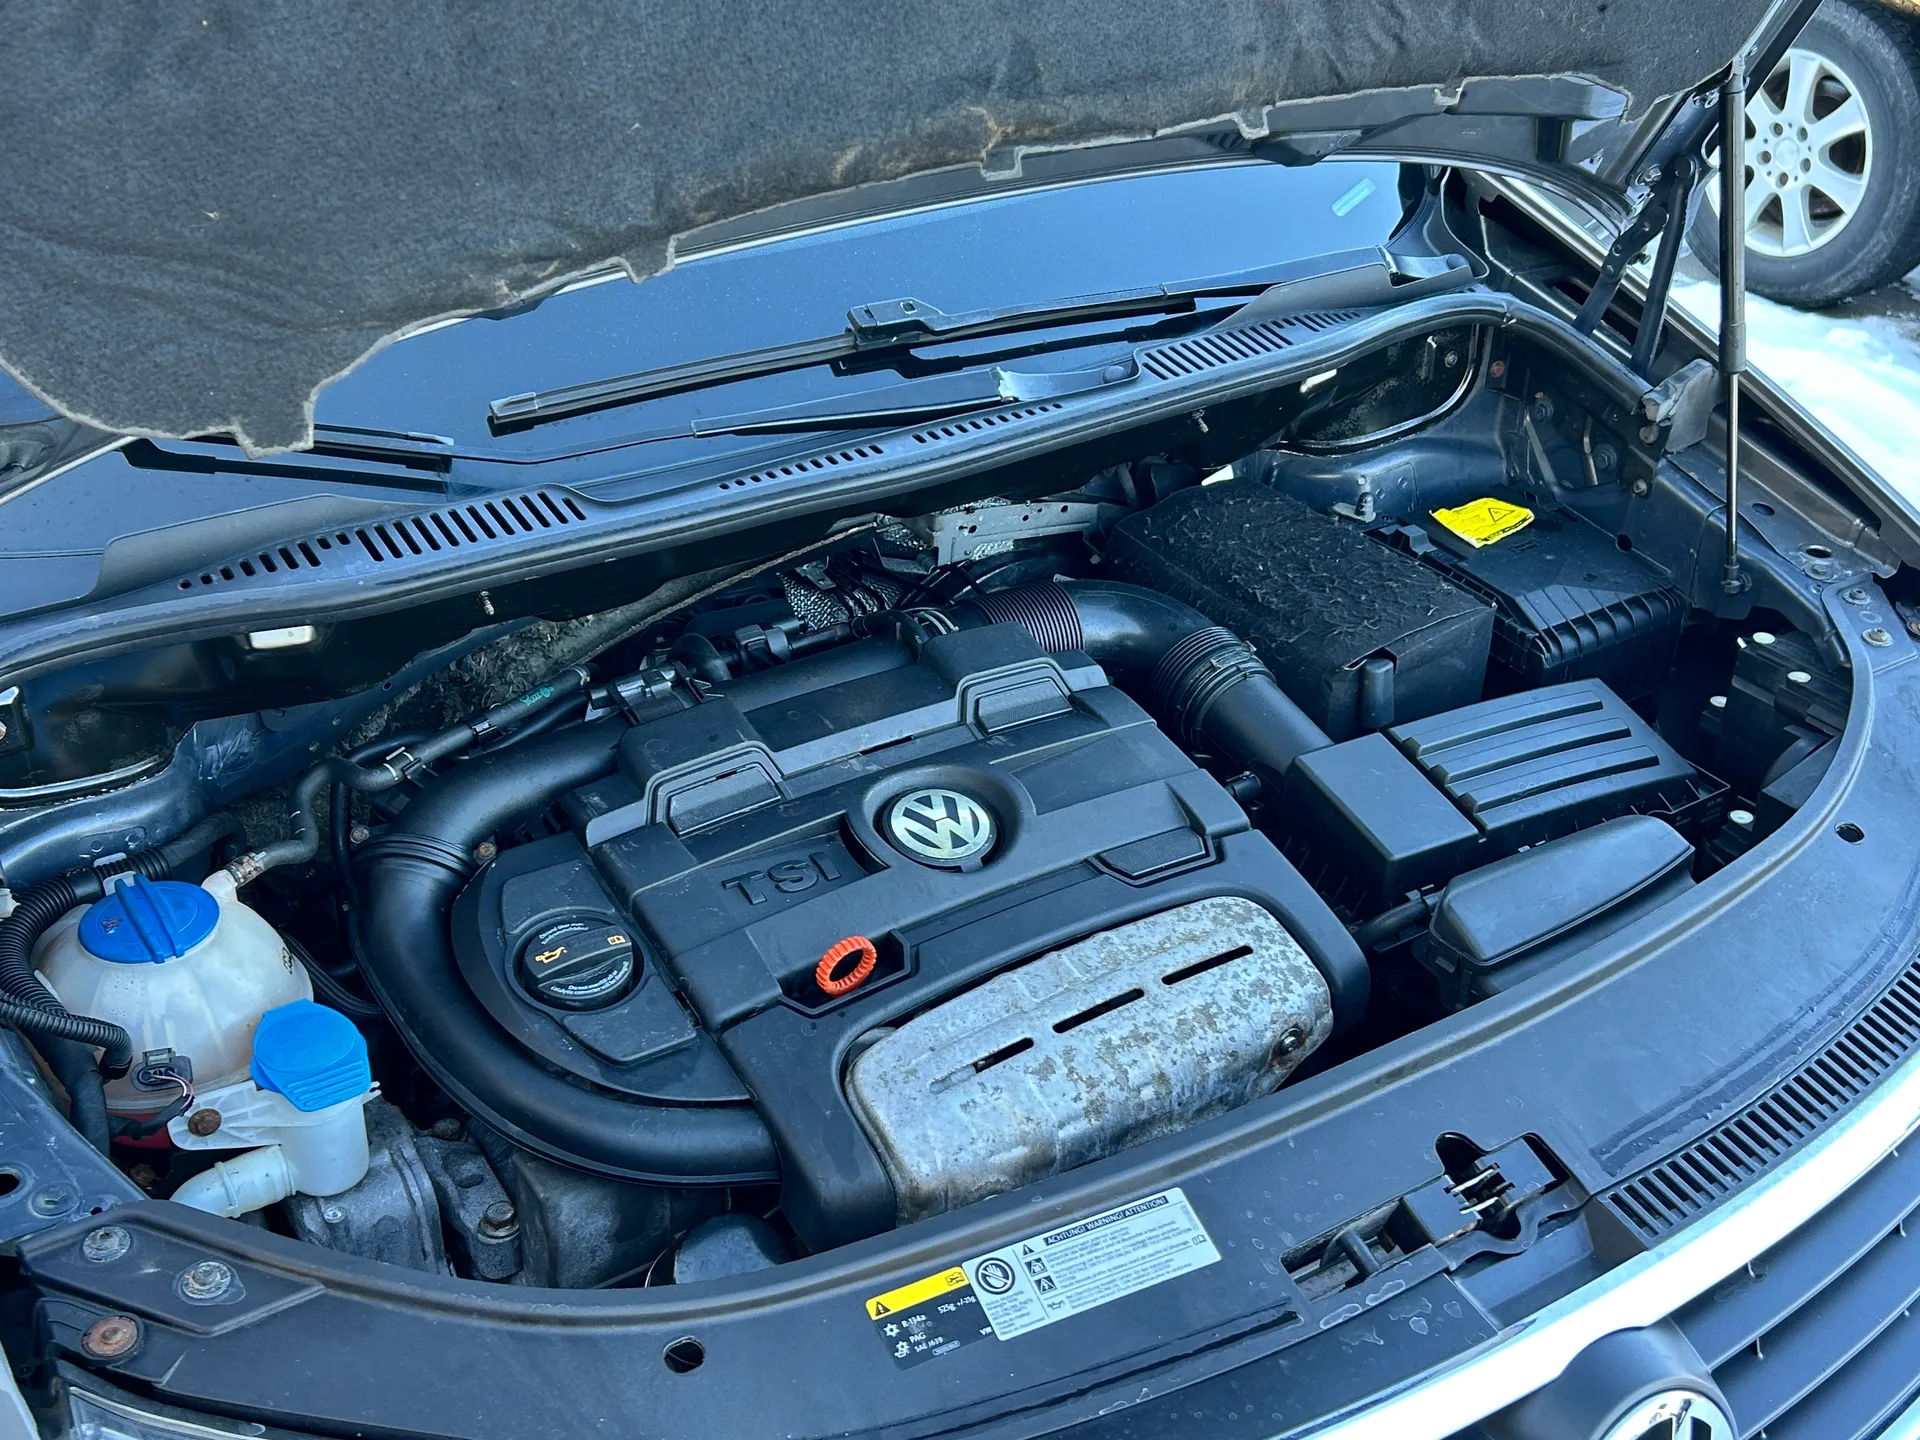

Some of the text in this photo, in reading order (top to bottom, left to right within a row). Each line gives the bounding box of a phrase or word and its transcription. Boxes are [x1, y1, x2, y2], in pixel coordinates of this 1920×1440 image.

[721, 851, 842, 905] TSI
[1047, 1197, 1166, 1245] ACHTUNG! WARNING! ATTENTION!
[909, 1332, 926, 1344] PAG
[914, 1342, 928, 1353] SAE
